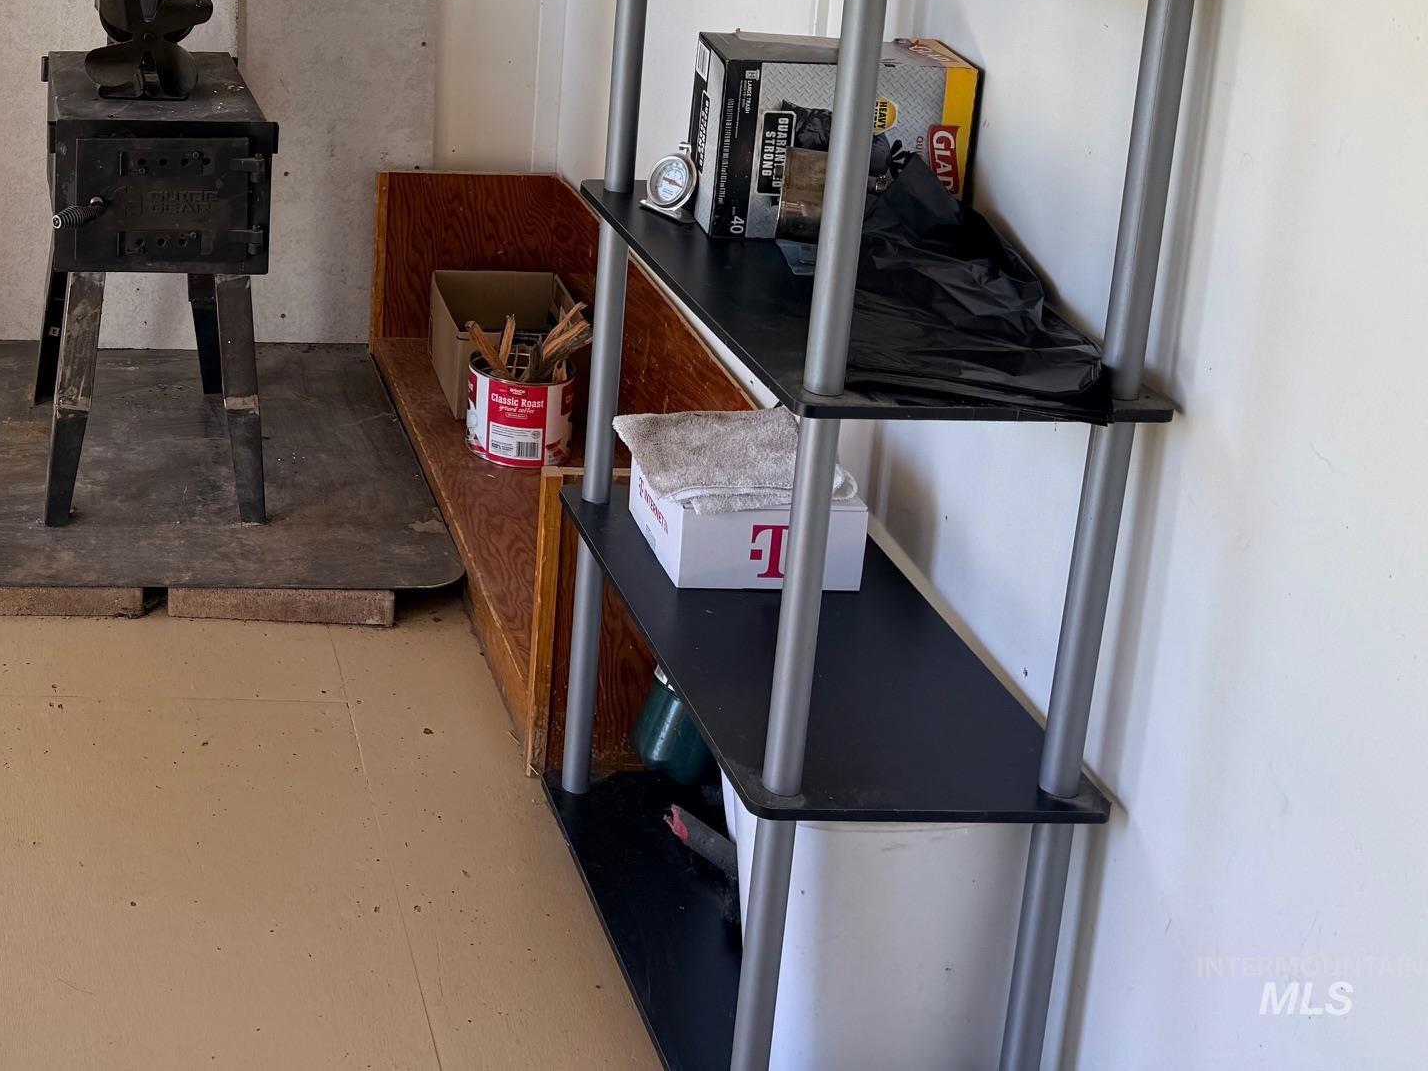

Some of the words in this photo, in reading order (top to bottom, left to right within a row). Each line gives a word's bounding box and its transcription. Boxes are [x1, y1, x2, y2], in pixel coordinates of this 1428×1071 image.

[879, 101, 888, 130] HEAVY
[761, 130, 777, 177] STRONG
[729, 215, 745, 234] 40
[491, 392, 519, 407] Classic
[520, 398, 544, 408] Roast
